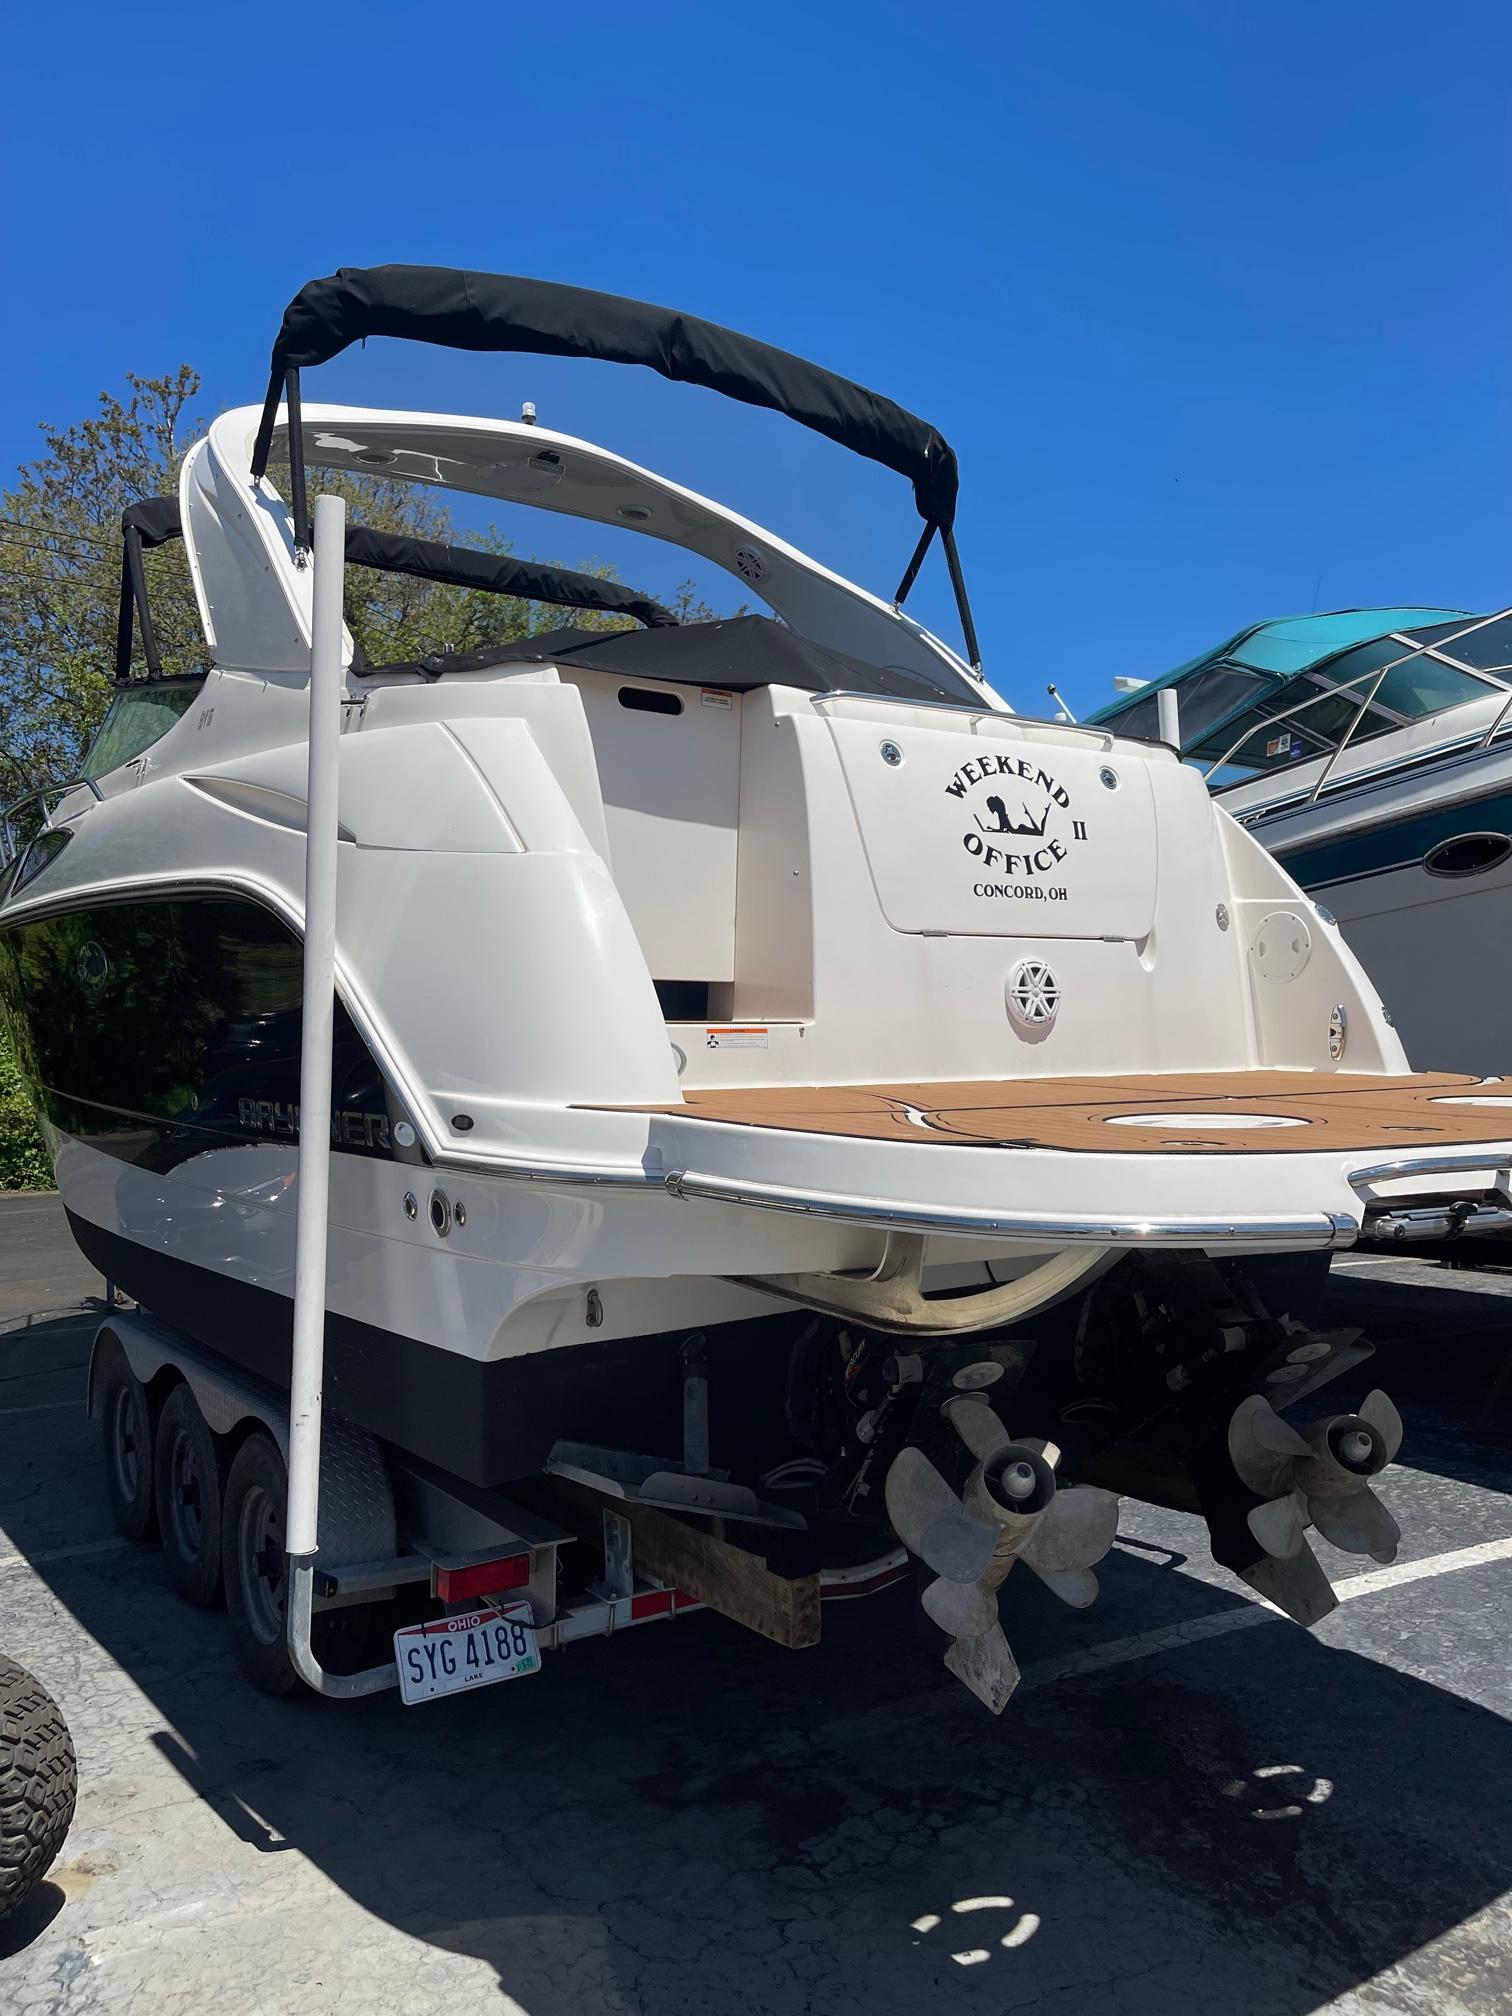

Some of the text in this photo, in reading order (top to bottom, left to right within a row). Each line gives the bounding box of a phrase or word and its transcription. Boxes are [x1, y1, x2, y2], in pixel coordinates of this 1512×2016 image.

[945, 755, 1070, 808] WEEKEND
[1072, 820, 1088, 841] II
[963, 833, 1068, 875] OFFICE
[447, 1616, 480, 1632] OHIO
[407, 1624, 527, 1684] SYG 4188
[464, 1672, 484, 1683] LAKE
